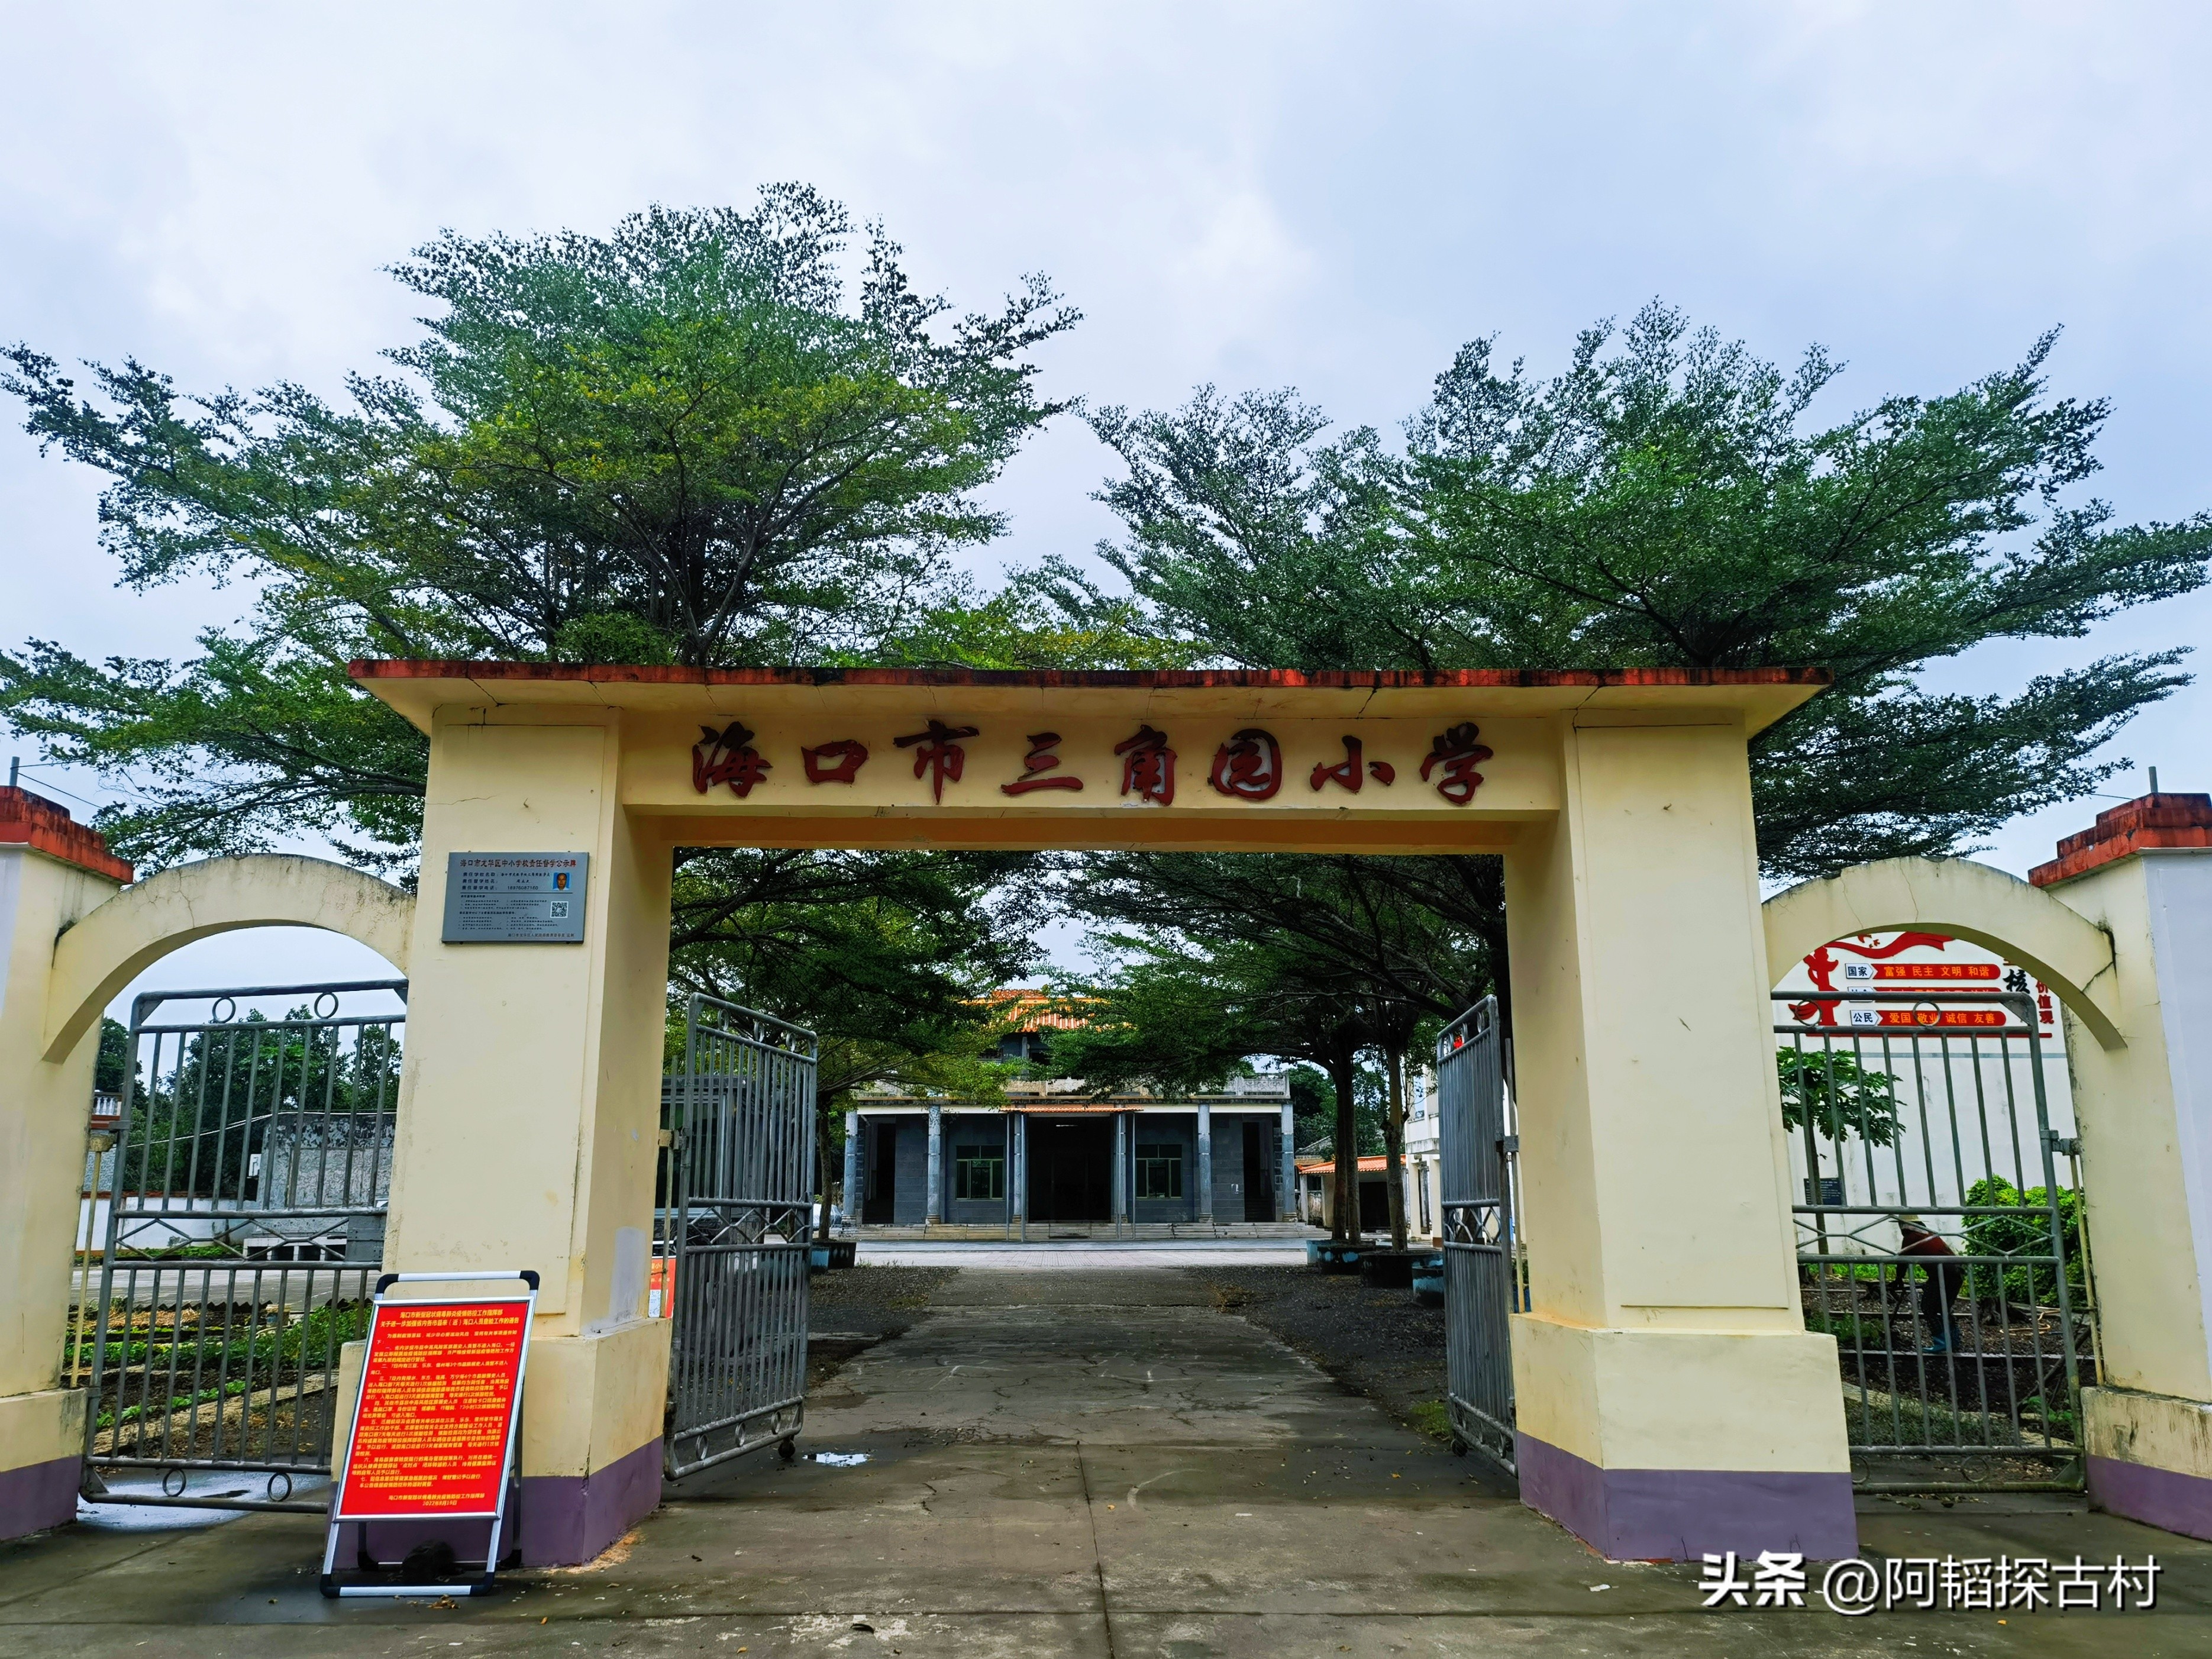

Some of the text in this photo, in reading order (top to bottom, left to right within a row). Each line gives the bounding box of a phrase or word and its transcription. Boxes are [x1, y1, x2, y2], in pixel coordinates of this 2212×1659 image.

[693, 720, 1495, 806] 海口市三角园小学
[1848, 966, 1868, 976] 国家
[1884, 966, 1990, 977] 富强 民主 文明 和谐
[2003, 969, 2030, 994] 核
[1853, 1012, 1873, 1023] 公民
[1889, 1012, 1995, 1024] 爱国 敬业 诚信 友善
